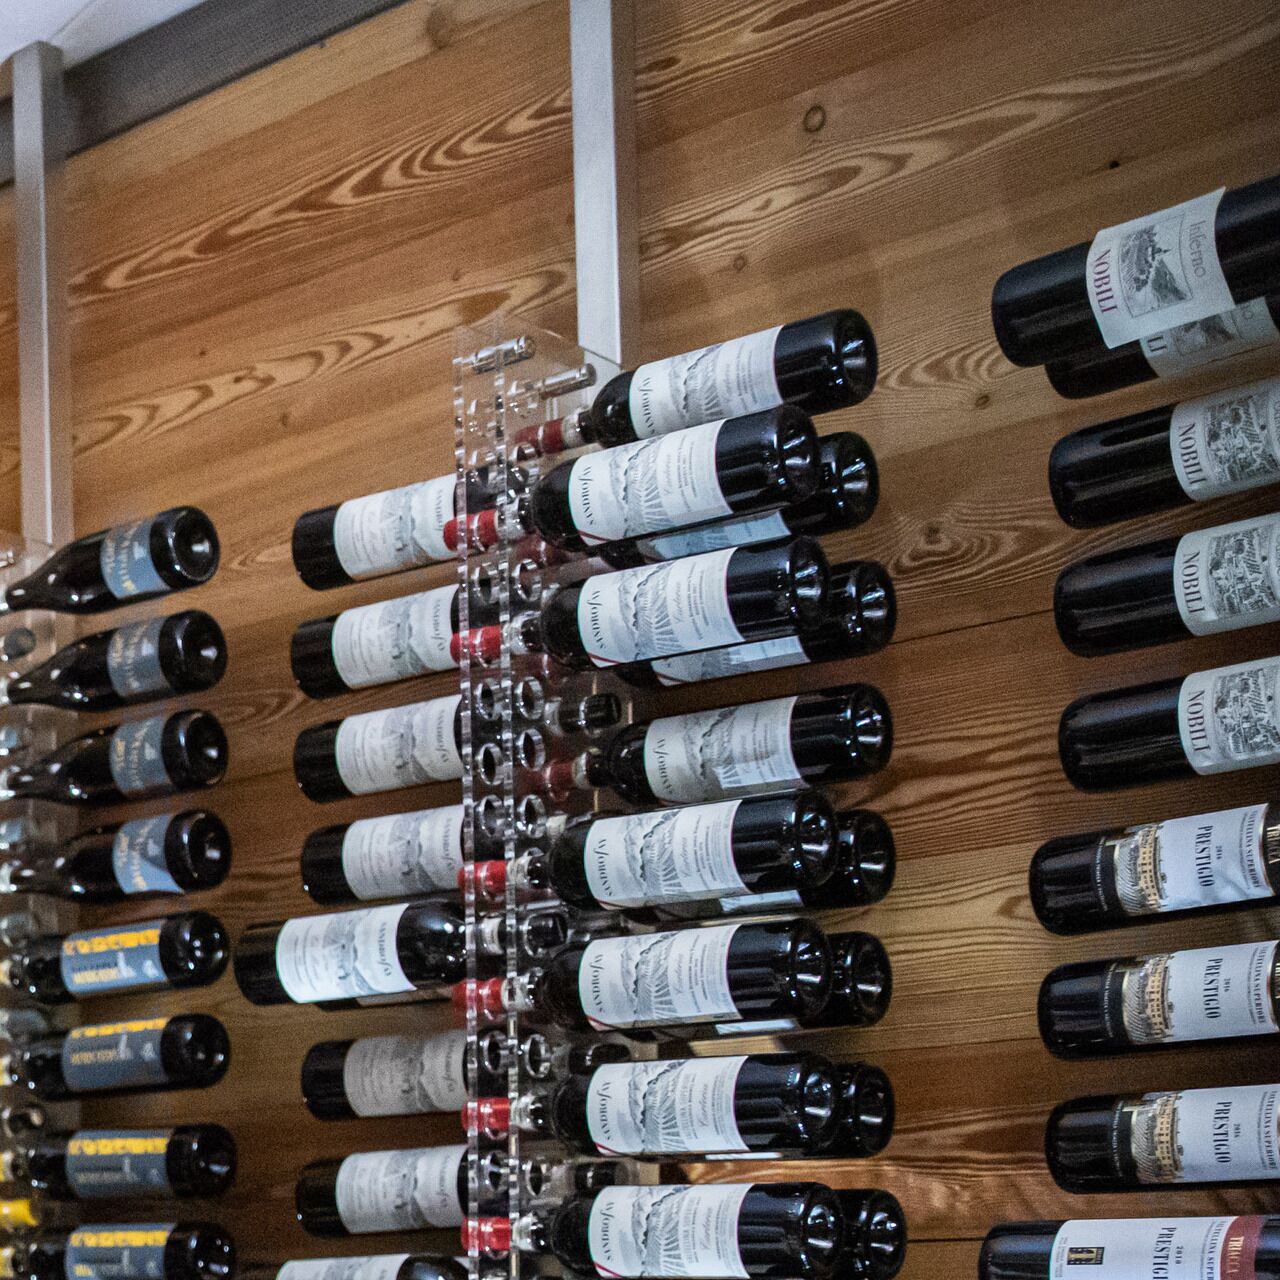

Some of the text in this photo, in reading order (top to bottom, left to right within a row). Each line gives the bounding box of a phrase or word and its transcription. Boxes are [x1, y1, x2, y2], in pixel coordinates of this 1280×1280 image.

[1092, 249, 1118, 314] NOBILI
[1179, 423, 1207, 486] NOBILI
[1182, 550, 1206, 613] NOBILI
[1188, 689, 1210, 752] NOBILI
[1195, 825, 1214, 888] PRESTIGIO
[1205, 957, 1223, 1020] PRESTIGIO
[1213, 1100, 1232, 1164] PRESTIGIO
[1175, 1245, 1183, 1265] 2010
[1207, 1219, 1226, 1254] VALTELLINA
[1226, 1235, 1244, 1274] TRIACCA
